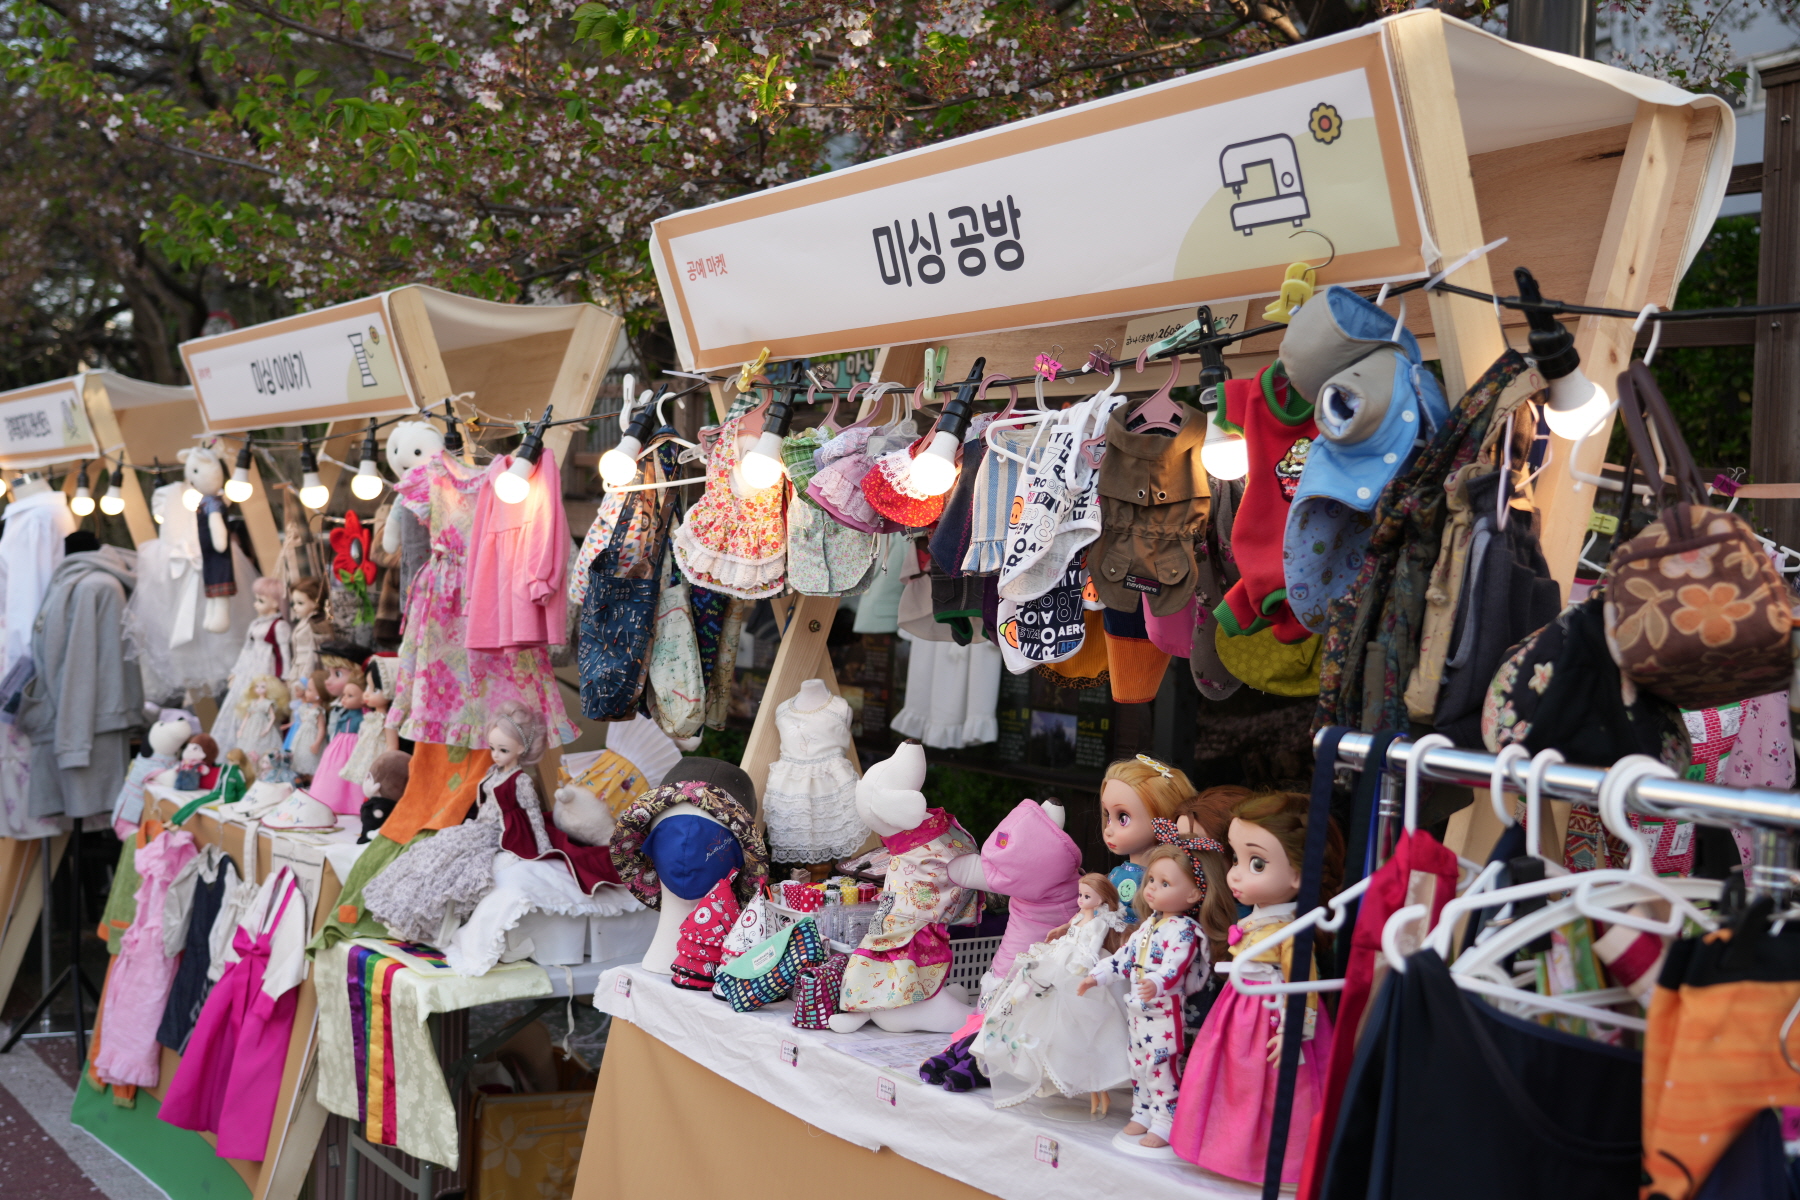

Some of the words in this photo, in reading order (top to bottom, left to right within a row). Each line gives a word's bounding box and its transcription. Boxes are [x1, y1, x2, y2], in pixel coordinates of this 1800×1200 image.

[686, 257, 708, 281] 공예
[706, 253, 728, 277] 마켓
[872, 211, 946, 287] 미싱
[947, 194, 1025, 275] 공방
